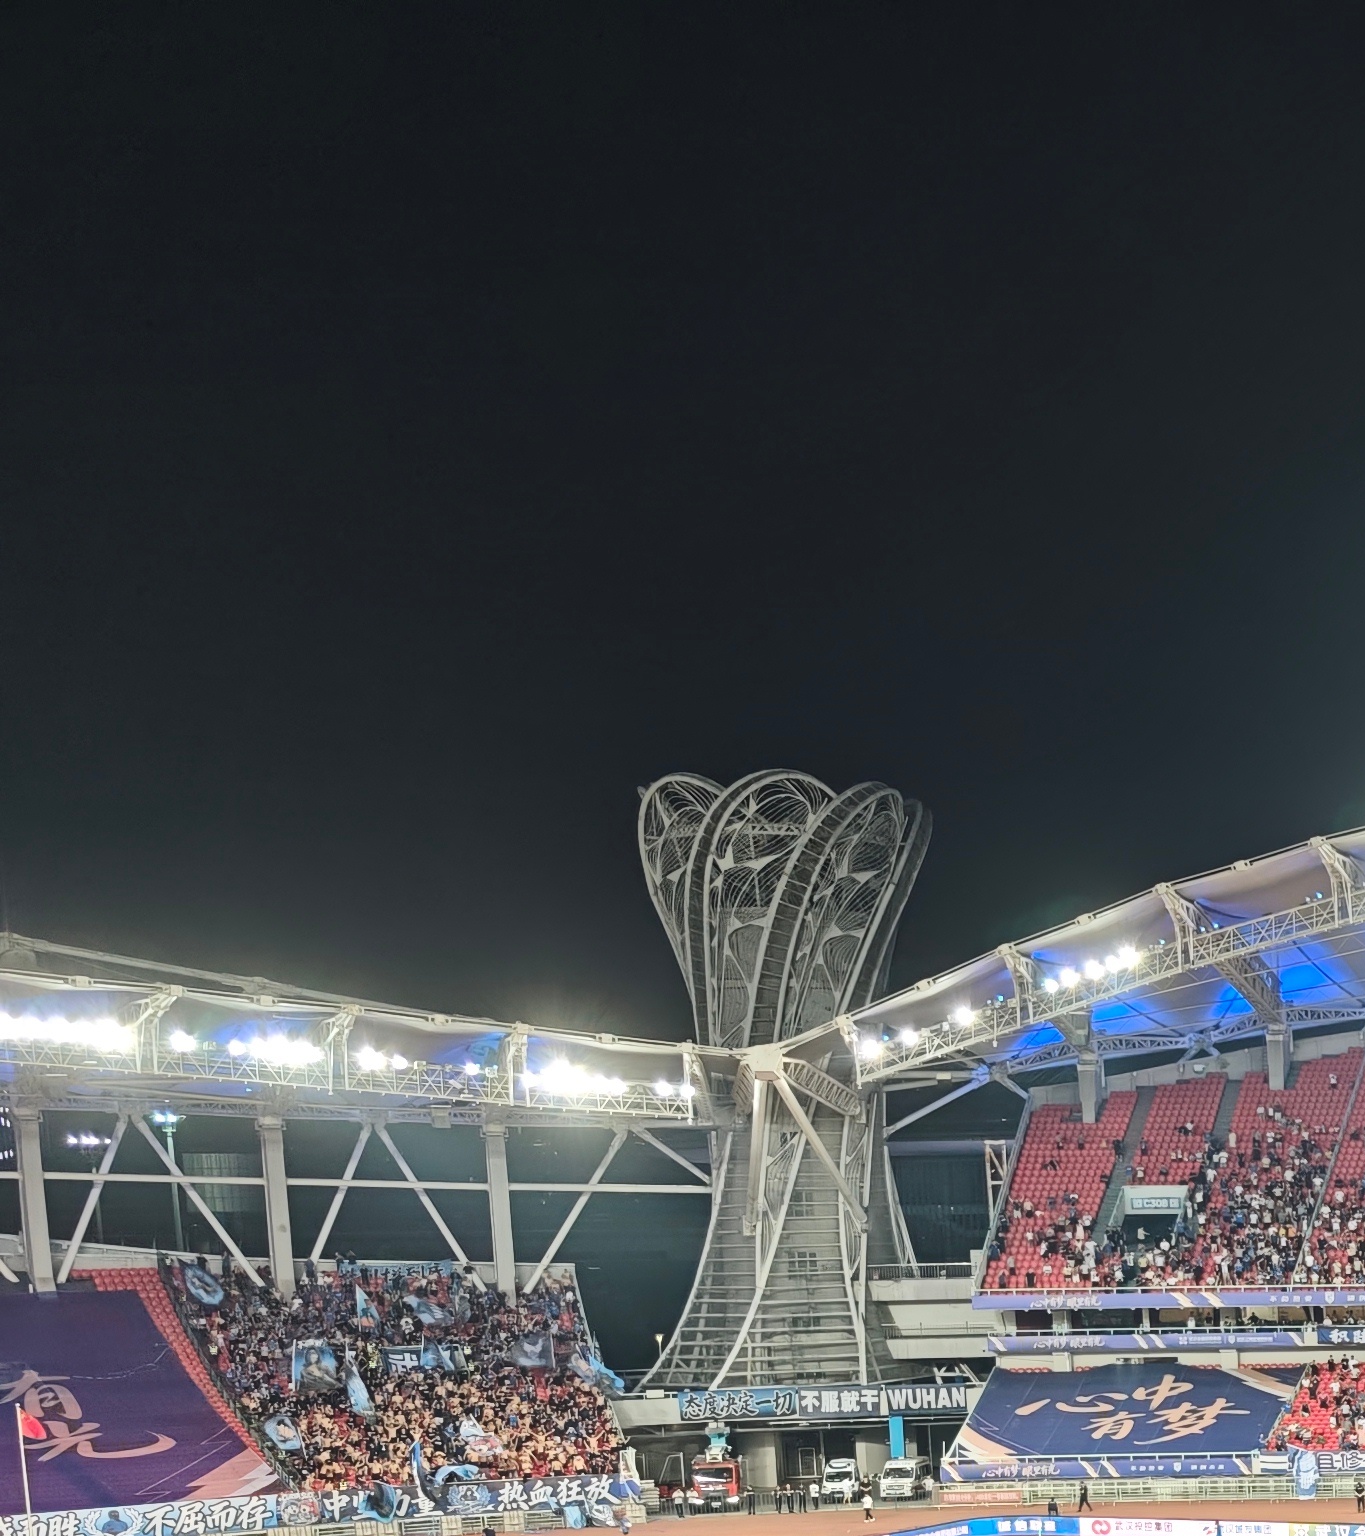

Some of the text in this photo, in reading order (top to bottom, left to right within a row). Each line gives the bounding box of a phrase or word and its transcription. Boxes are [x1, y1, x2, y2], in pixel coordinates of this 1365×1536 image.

[682, 1390, 794, 1420] 态度决定一切
[800, 1389, 880, 1414] 不服就干
[887, 1385, 967, 1411] WUHAN
[1014, 1373, 1195, 1416] 心中
[1081, 1398, 1251, 1446] 有梦
[497, 1476, 620, 1512] 热血狂放
